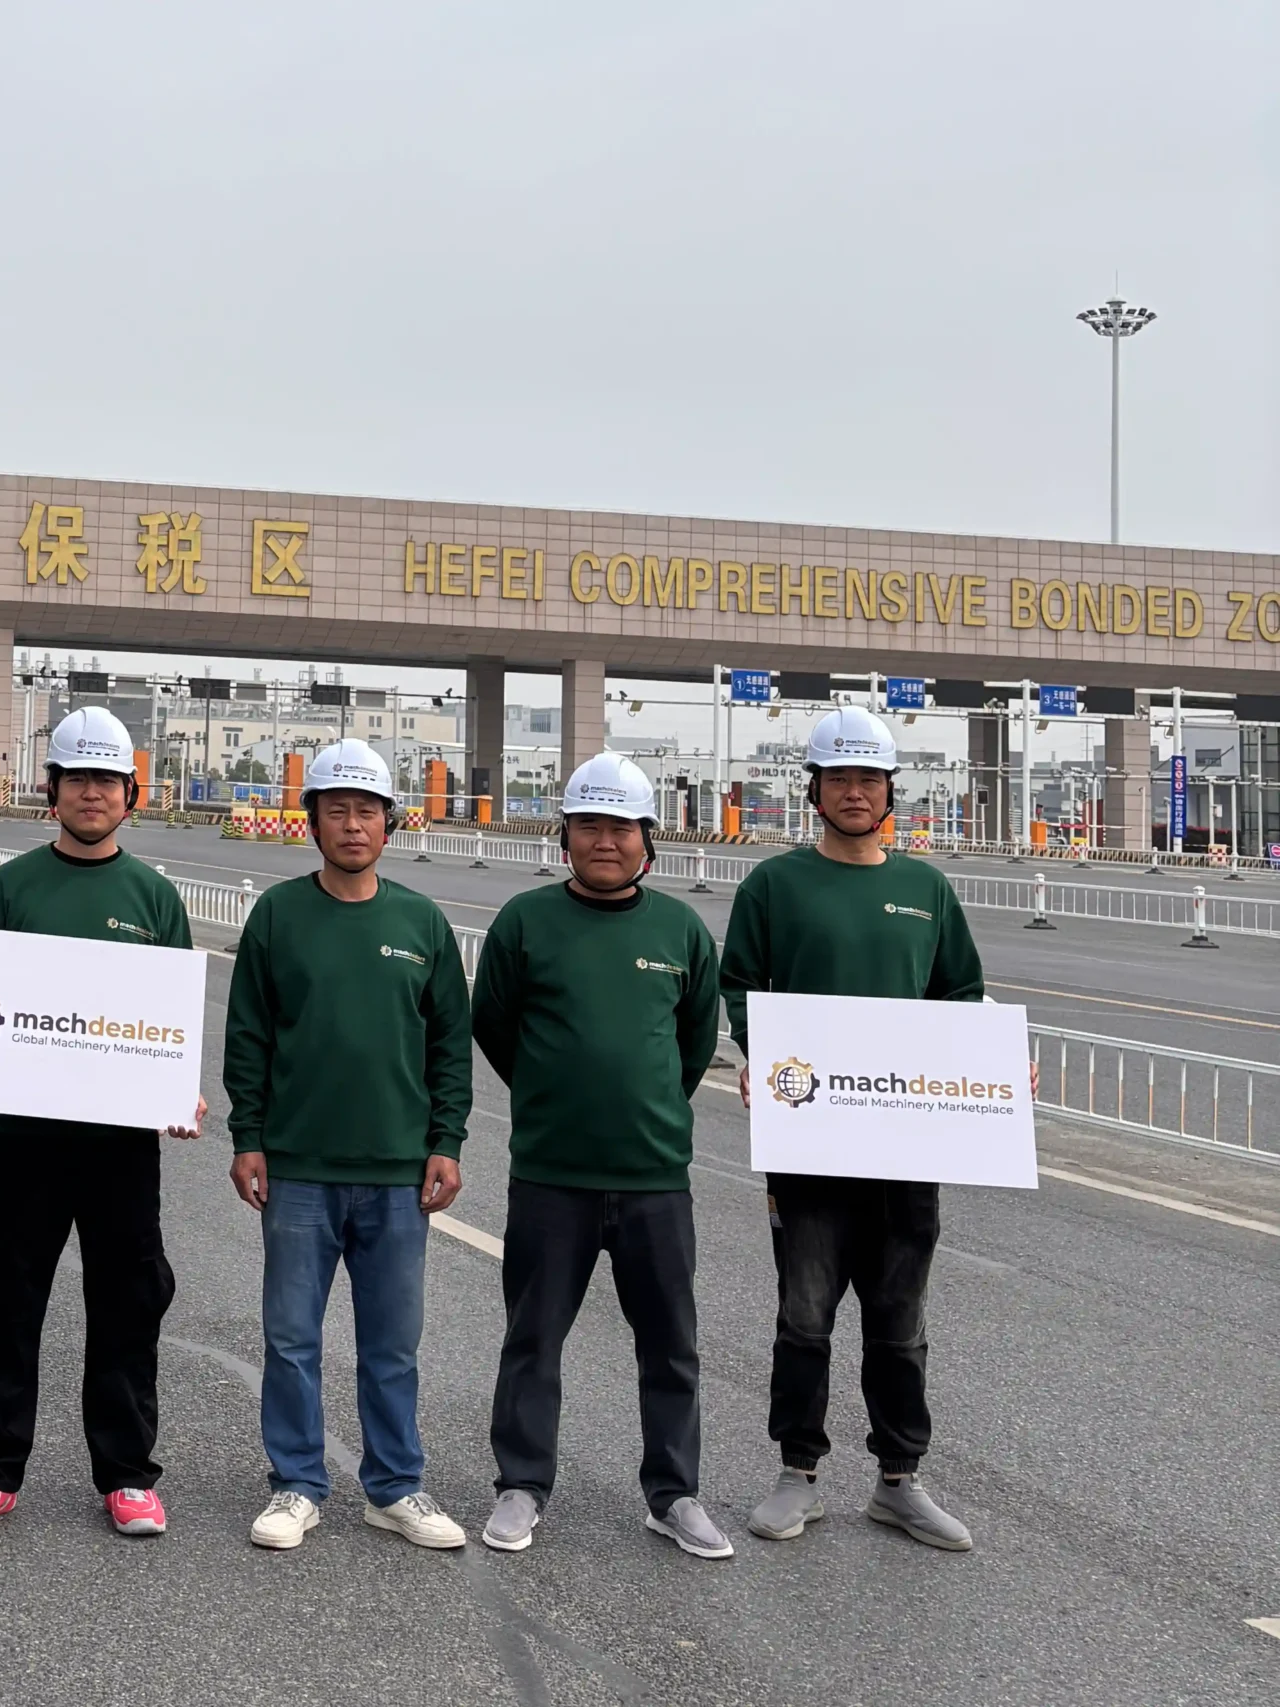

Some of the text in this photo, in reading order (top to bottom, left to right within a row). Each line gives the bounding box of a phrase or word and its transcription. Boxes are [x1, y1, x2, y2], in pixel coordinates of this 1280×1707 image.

[404, 540, 545, 602] HEFEI
[570, 549, 987, 627] COMPREHENSIVE
[1010, 577, 1204, 639] BONDED
[12, 1011, 186, 1045] machdealers
[11, 1032, 184, 1060] Global Machinery Marketplace
[828, 1072, 1014, 1100] machdealers
[829, 1095, 1014, 1116] Global Machinery Marketplace
